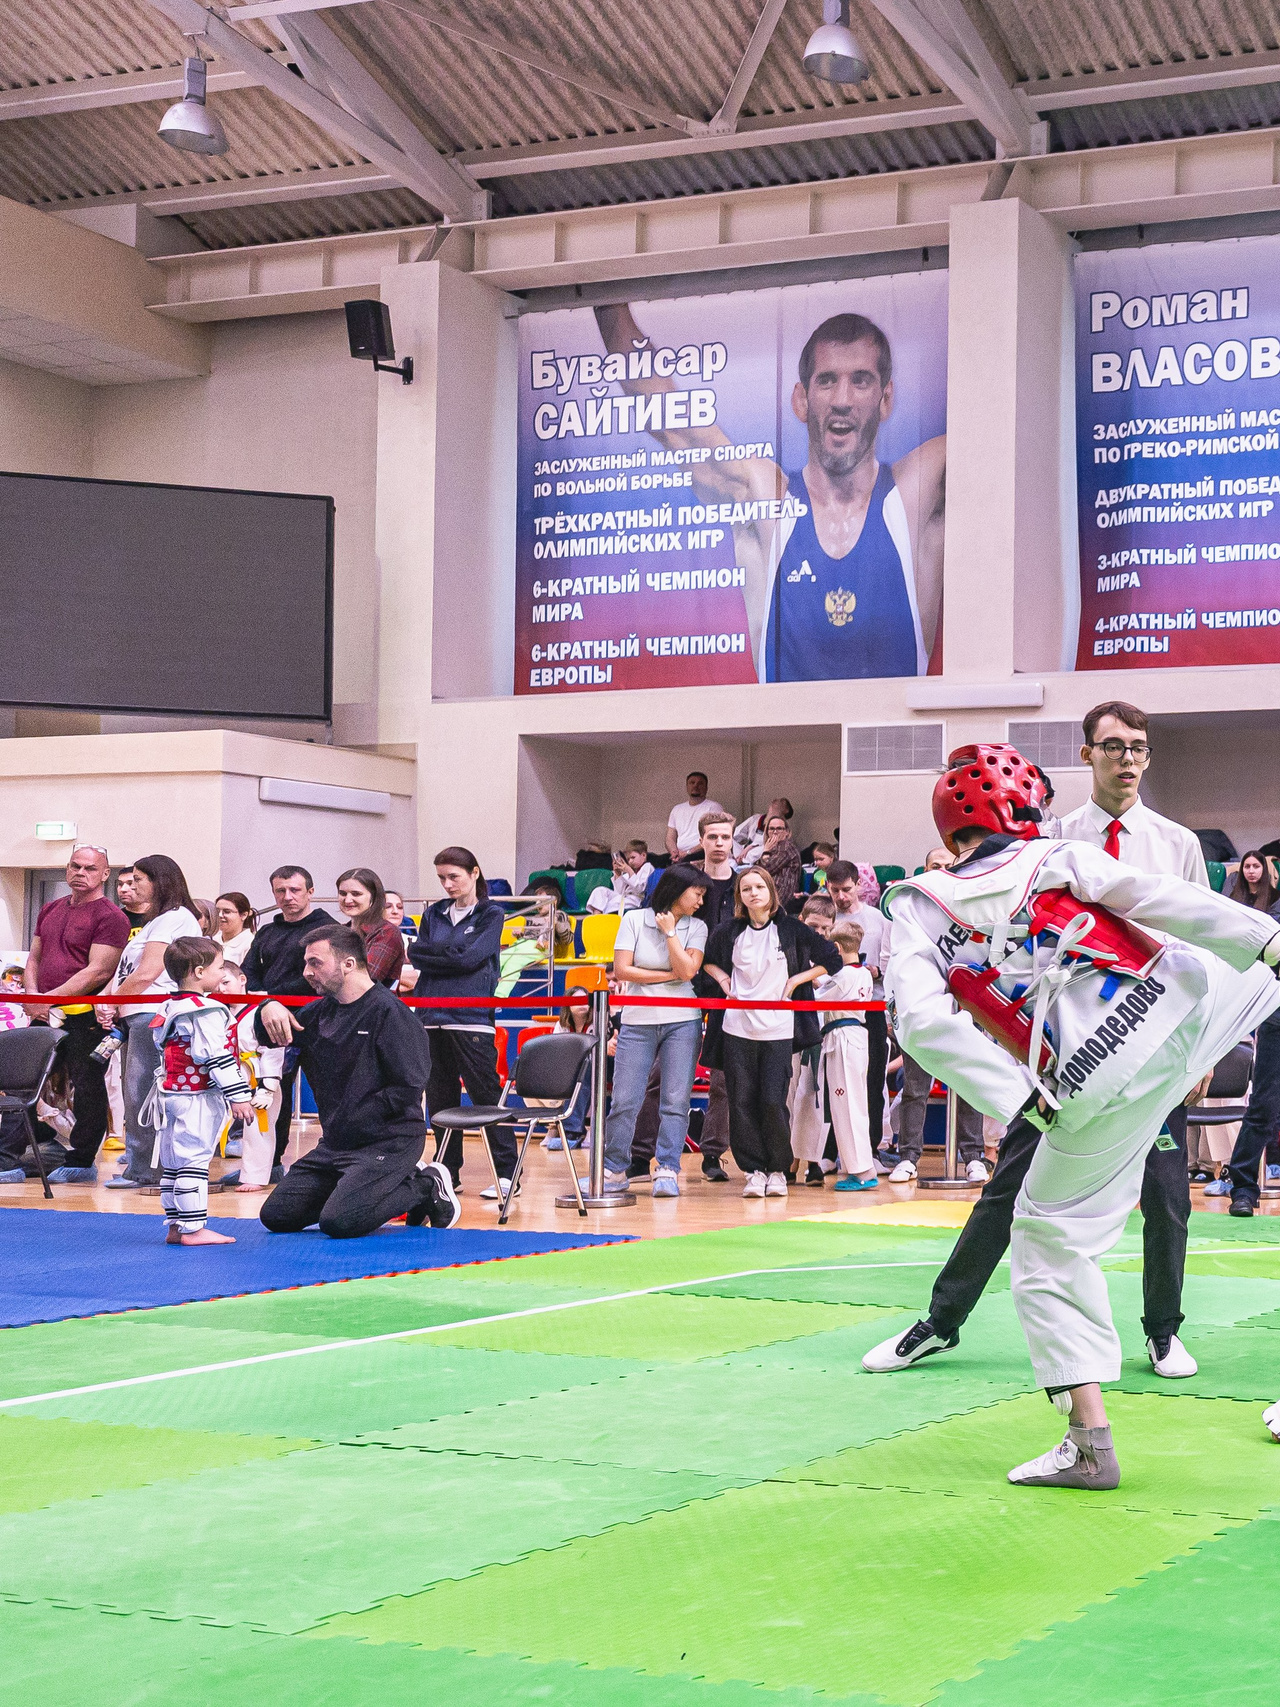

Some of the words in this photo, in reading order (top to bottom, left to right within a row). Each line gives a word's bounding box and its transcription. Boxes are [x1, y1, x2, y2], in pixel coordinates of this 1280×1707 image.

[1090, 286, 1249, 333] Роман
[531, 337, 727, 393] Бувайсар
[534, 387, 717, 439] САЙТИЕВ
[1093, 408, 1235, 440] ЗАСЛУЖЕННЫЙ
[534, 448, 646, 476] ЗАСЛУЖЕННЫЙ
[651, 448, 711, 467] МАСТЕР
[714, 442, 774, 461] СПОРТА
[1094, 444, 1120, 464] ПО
[1124, 430, 1279, 460] ГРЕКО-РИМСКОЙ
[534, 482, 552, 498] ПО
[556, 474, 628, 495] ВОЛЬНОЙ
[631, 471, 693, 491] БОРЬБЕ
[1095, 476, 1216, 508] ДВУКРАТНЫЙ
[534, 502, 672, 536] ТРЁХКРАТНЫЙ
[678, 497, 808, 526] ПОБЕДИТЕЛЬ
[1096, 499, 1235, 529] ОЛИМПИЙСКИХ
[1239, 499, 1274, 520] ИГР
[534, 530, 682, 559] ОЛИМПИЙСКИХ
[687, 529, 724, 550] ИГР
[1097, 543, 1197, 571] 3-КРАТНЫЙ
[532, 568, 640, 598] 6-КРАТНЫЙ
[646, 567, 746, 591] ЧЕМПИОН
[1097, 571, 1140, 593] МИРА
[532, 602, 584, 623] МИРА
[1095, 607, 1197, 634] 4-КРАТНЫЙ
[531, 634, 639, 662] 6-КРАТНЫЙ
[646, 633, 746, 657] ЧЕМПИОН
[1093, 634, 1170, 657] ЕВРОПЫ
[530, 665, 612, 687] ЕВРОПЫ
